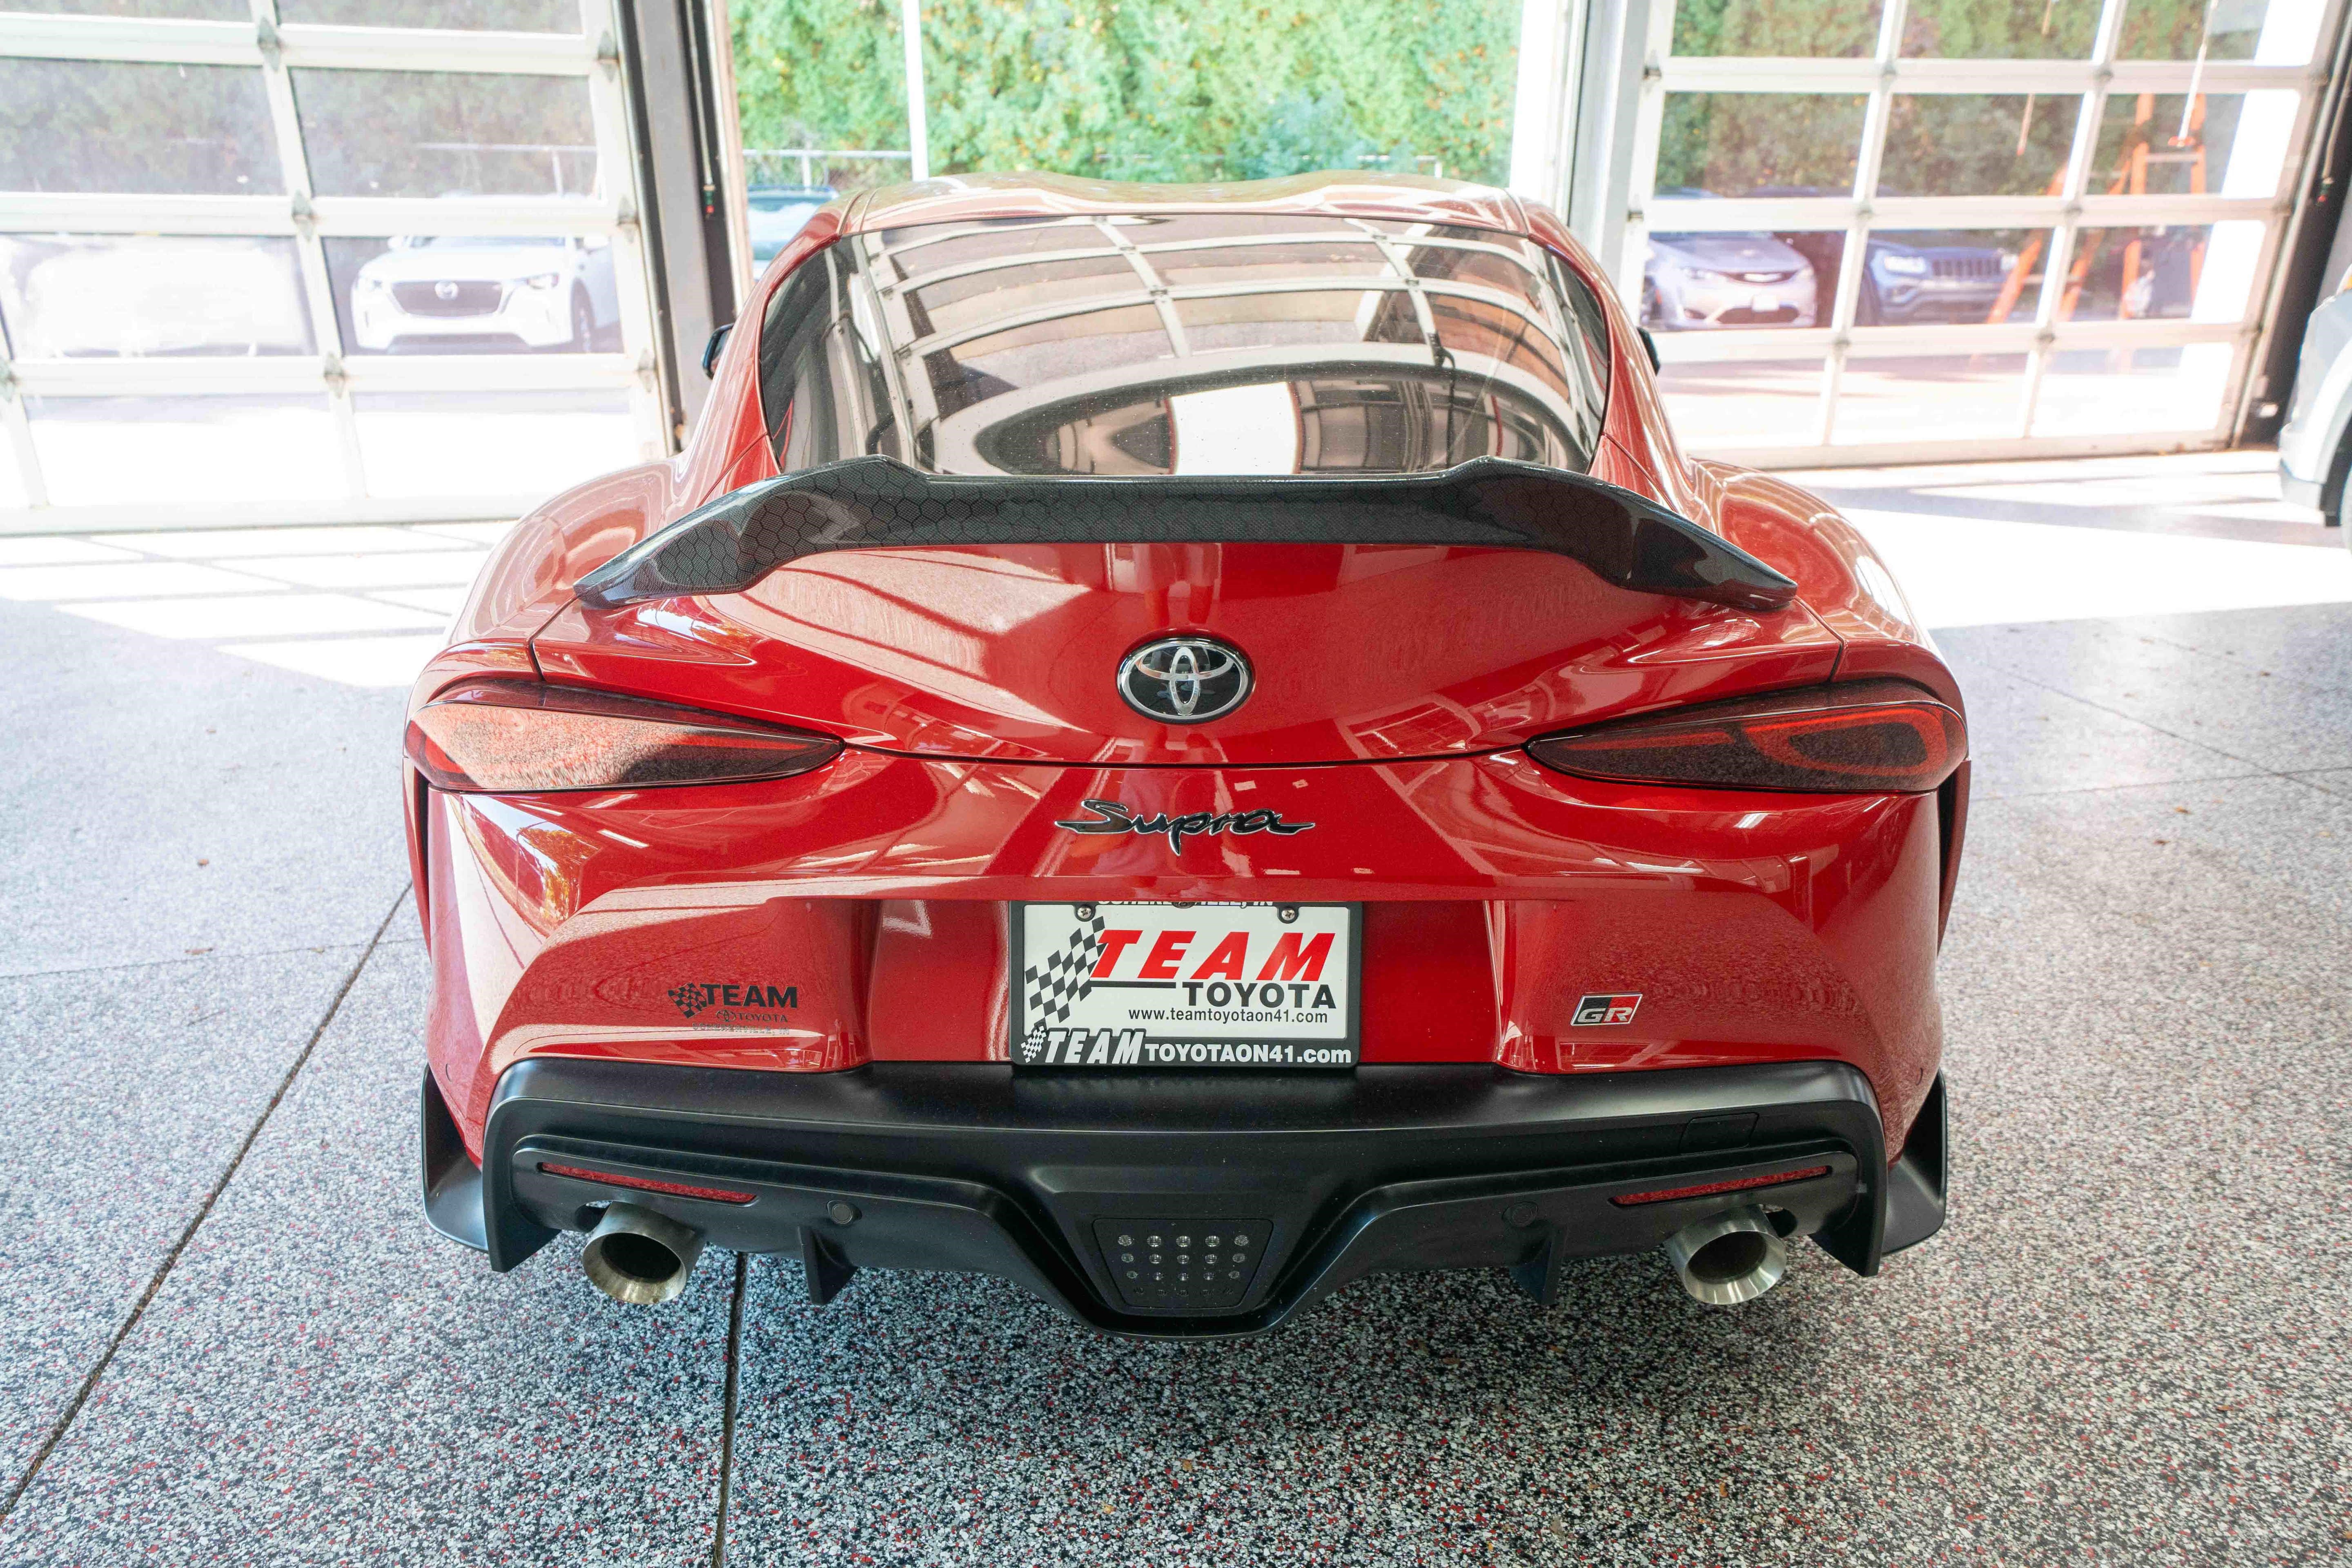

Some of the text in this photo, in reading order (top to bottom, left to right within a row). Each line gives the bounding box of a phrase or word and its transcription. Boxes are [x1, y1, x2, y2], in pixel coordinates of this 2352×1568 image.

[1055, 799, 1315, 856] Supra
[1090, 930, 1335, 981] TEAM
[699, 983, 797, 1008] TEAM
[1183, 982, 1336, 1009] TOYOTA
[739, 1013, 788, 1022] TOYOTA
[1129, 1007, 1328, 1023] www.teamtoyotaon41.com
[1578, 1007, 1633, 1022] GR
[1046, 1029, 1351, 1064] TEAM TOYOTAON41.com
